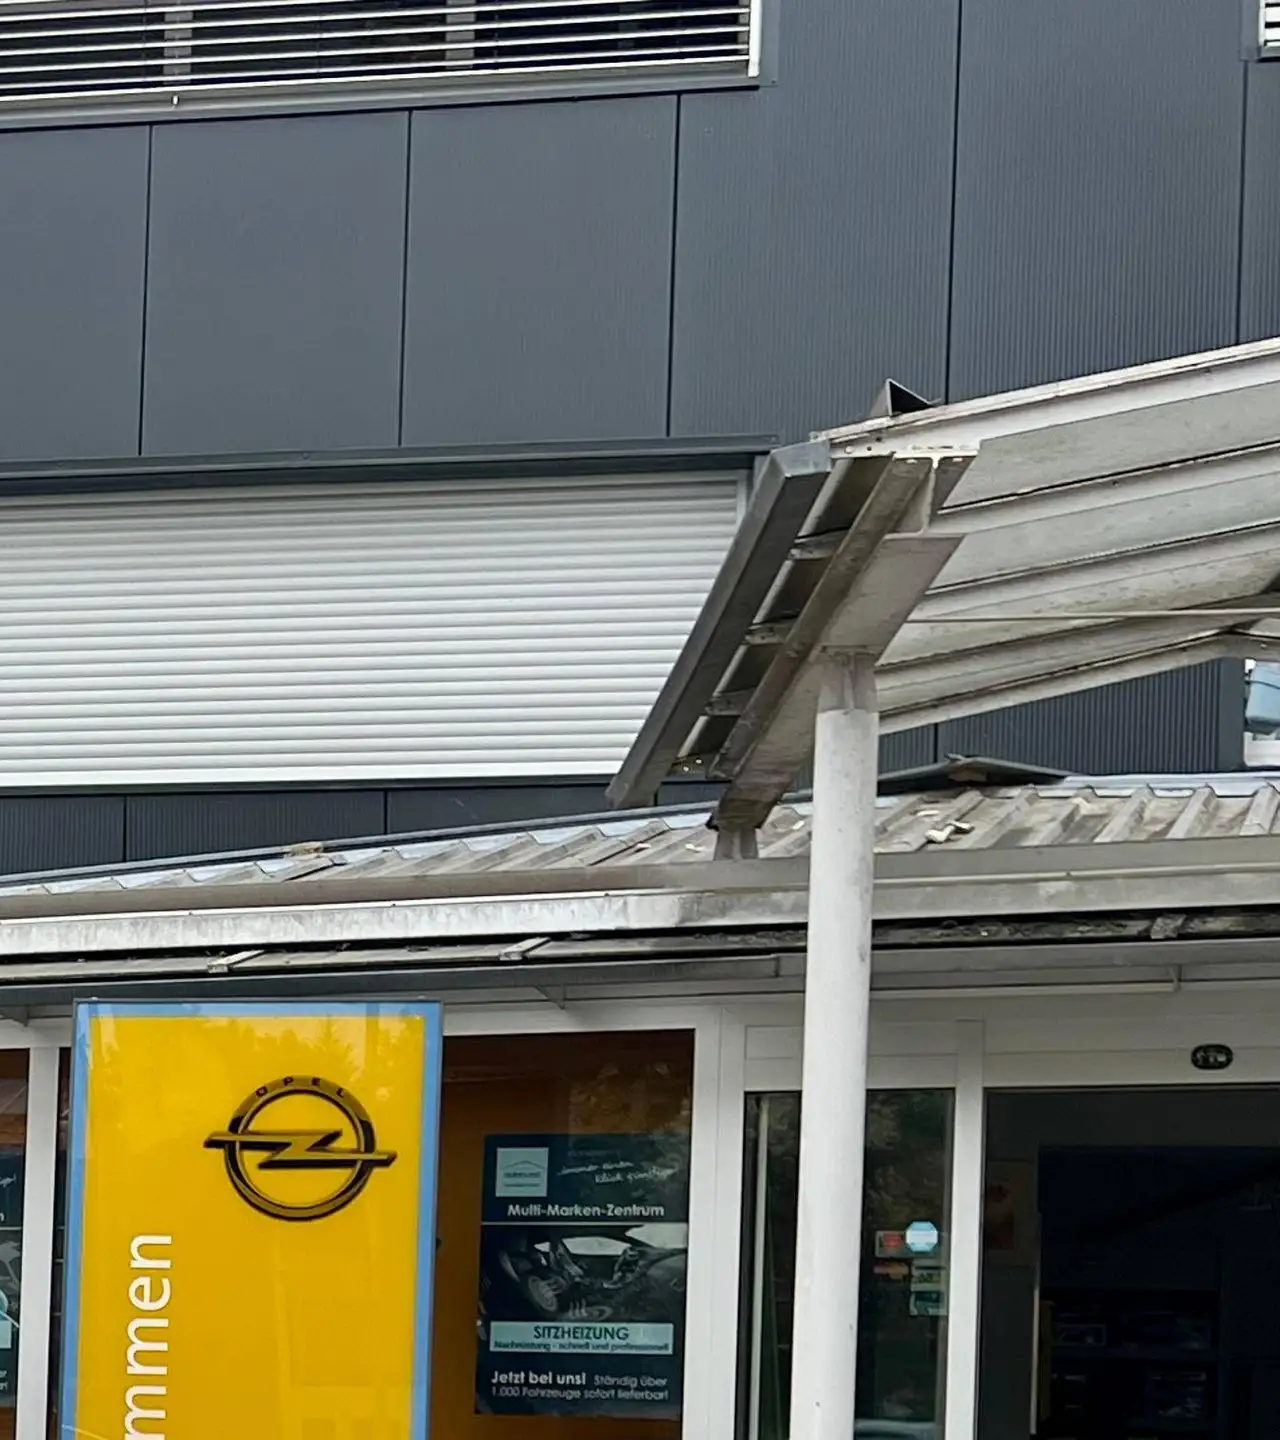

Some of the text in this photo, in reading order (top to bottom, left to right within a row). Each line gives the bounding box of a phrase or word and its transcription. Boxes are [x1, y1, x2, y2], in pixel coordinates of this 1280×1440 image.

[507, 1204, 665, 1218] Multi-Marken-Zentrum
[533, 1326, 629, 1340] SITZHEIZUNG
[490, 1371, 525, 1384] Jetzt
[528, 1371, 553, 1384] bei
